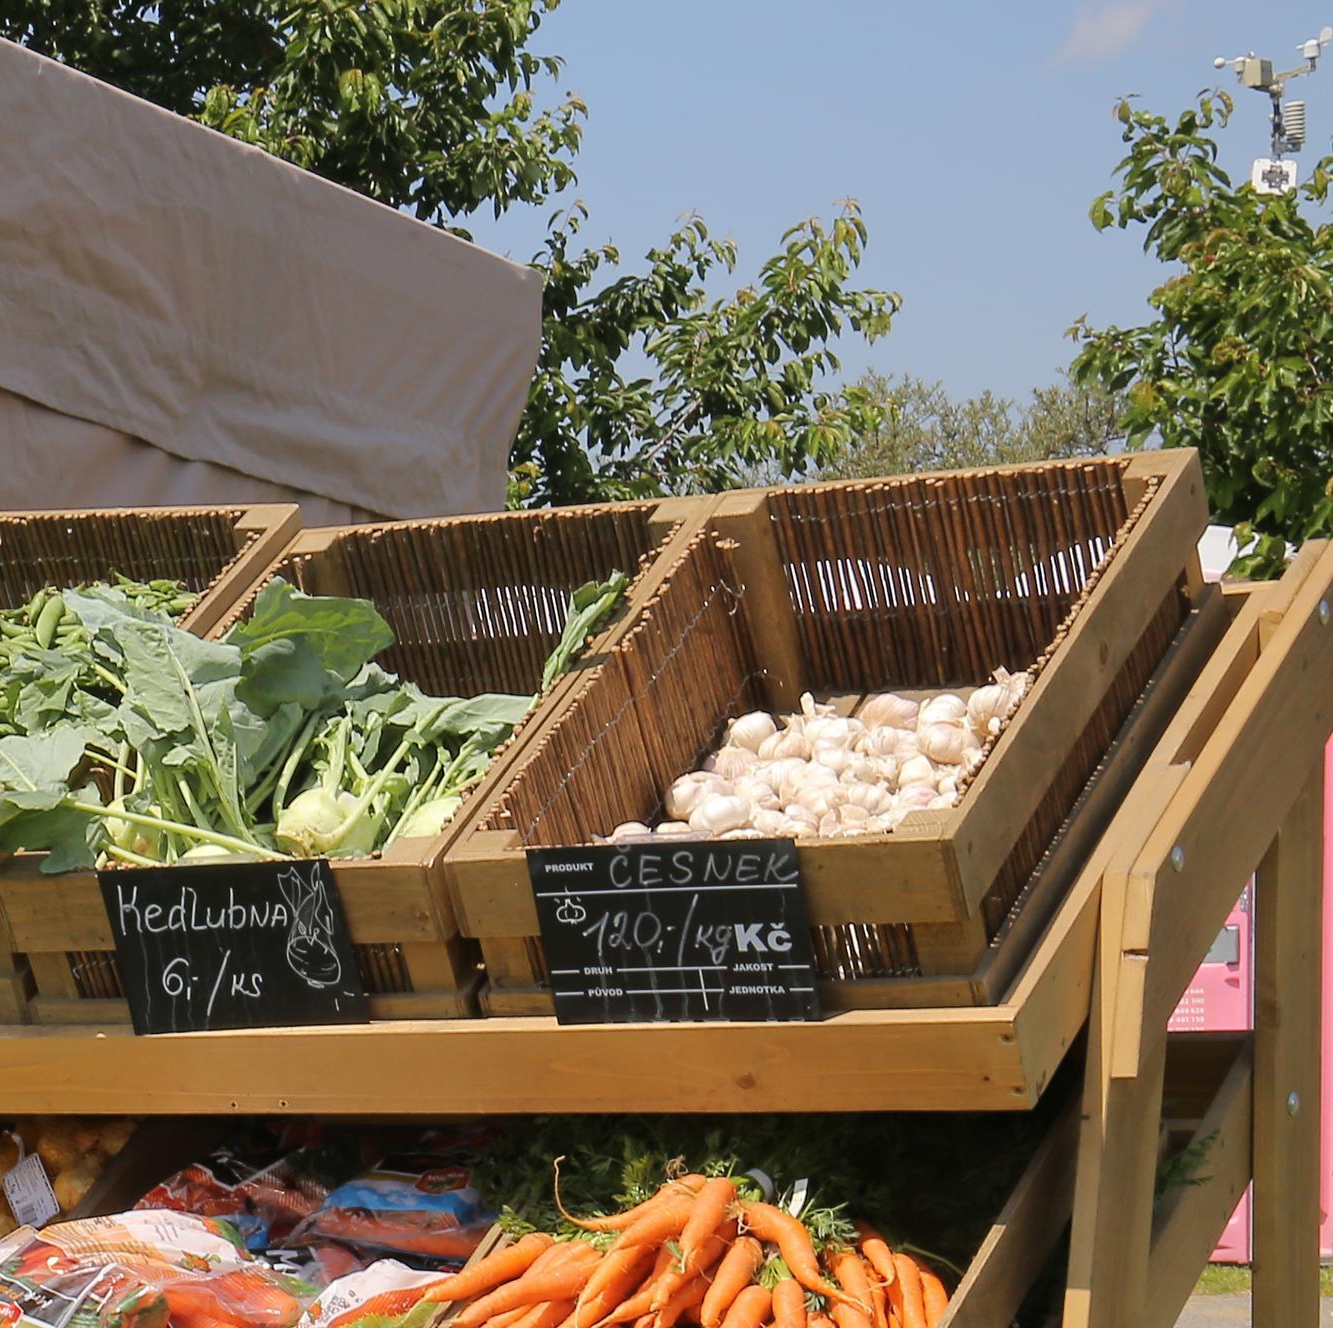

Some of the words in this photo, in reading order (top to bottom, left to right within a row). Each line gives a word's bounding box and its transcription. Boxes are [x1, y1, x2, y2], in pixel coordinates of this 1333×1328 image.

[545, 862, 594, 873] PRODUKT
[734, 922, 793, 952] Kč
[584, 966, 613, 975] DRUH
[733, 962, 774, 972] JAKOST
[588, 986, 623, 997] PŮVOD
[729, 985, 786, 995] JEDNOTKA
